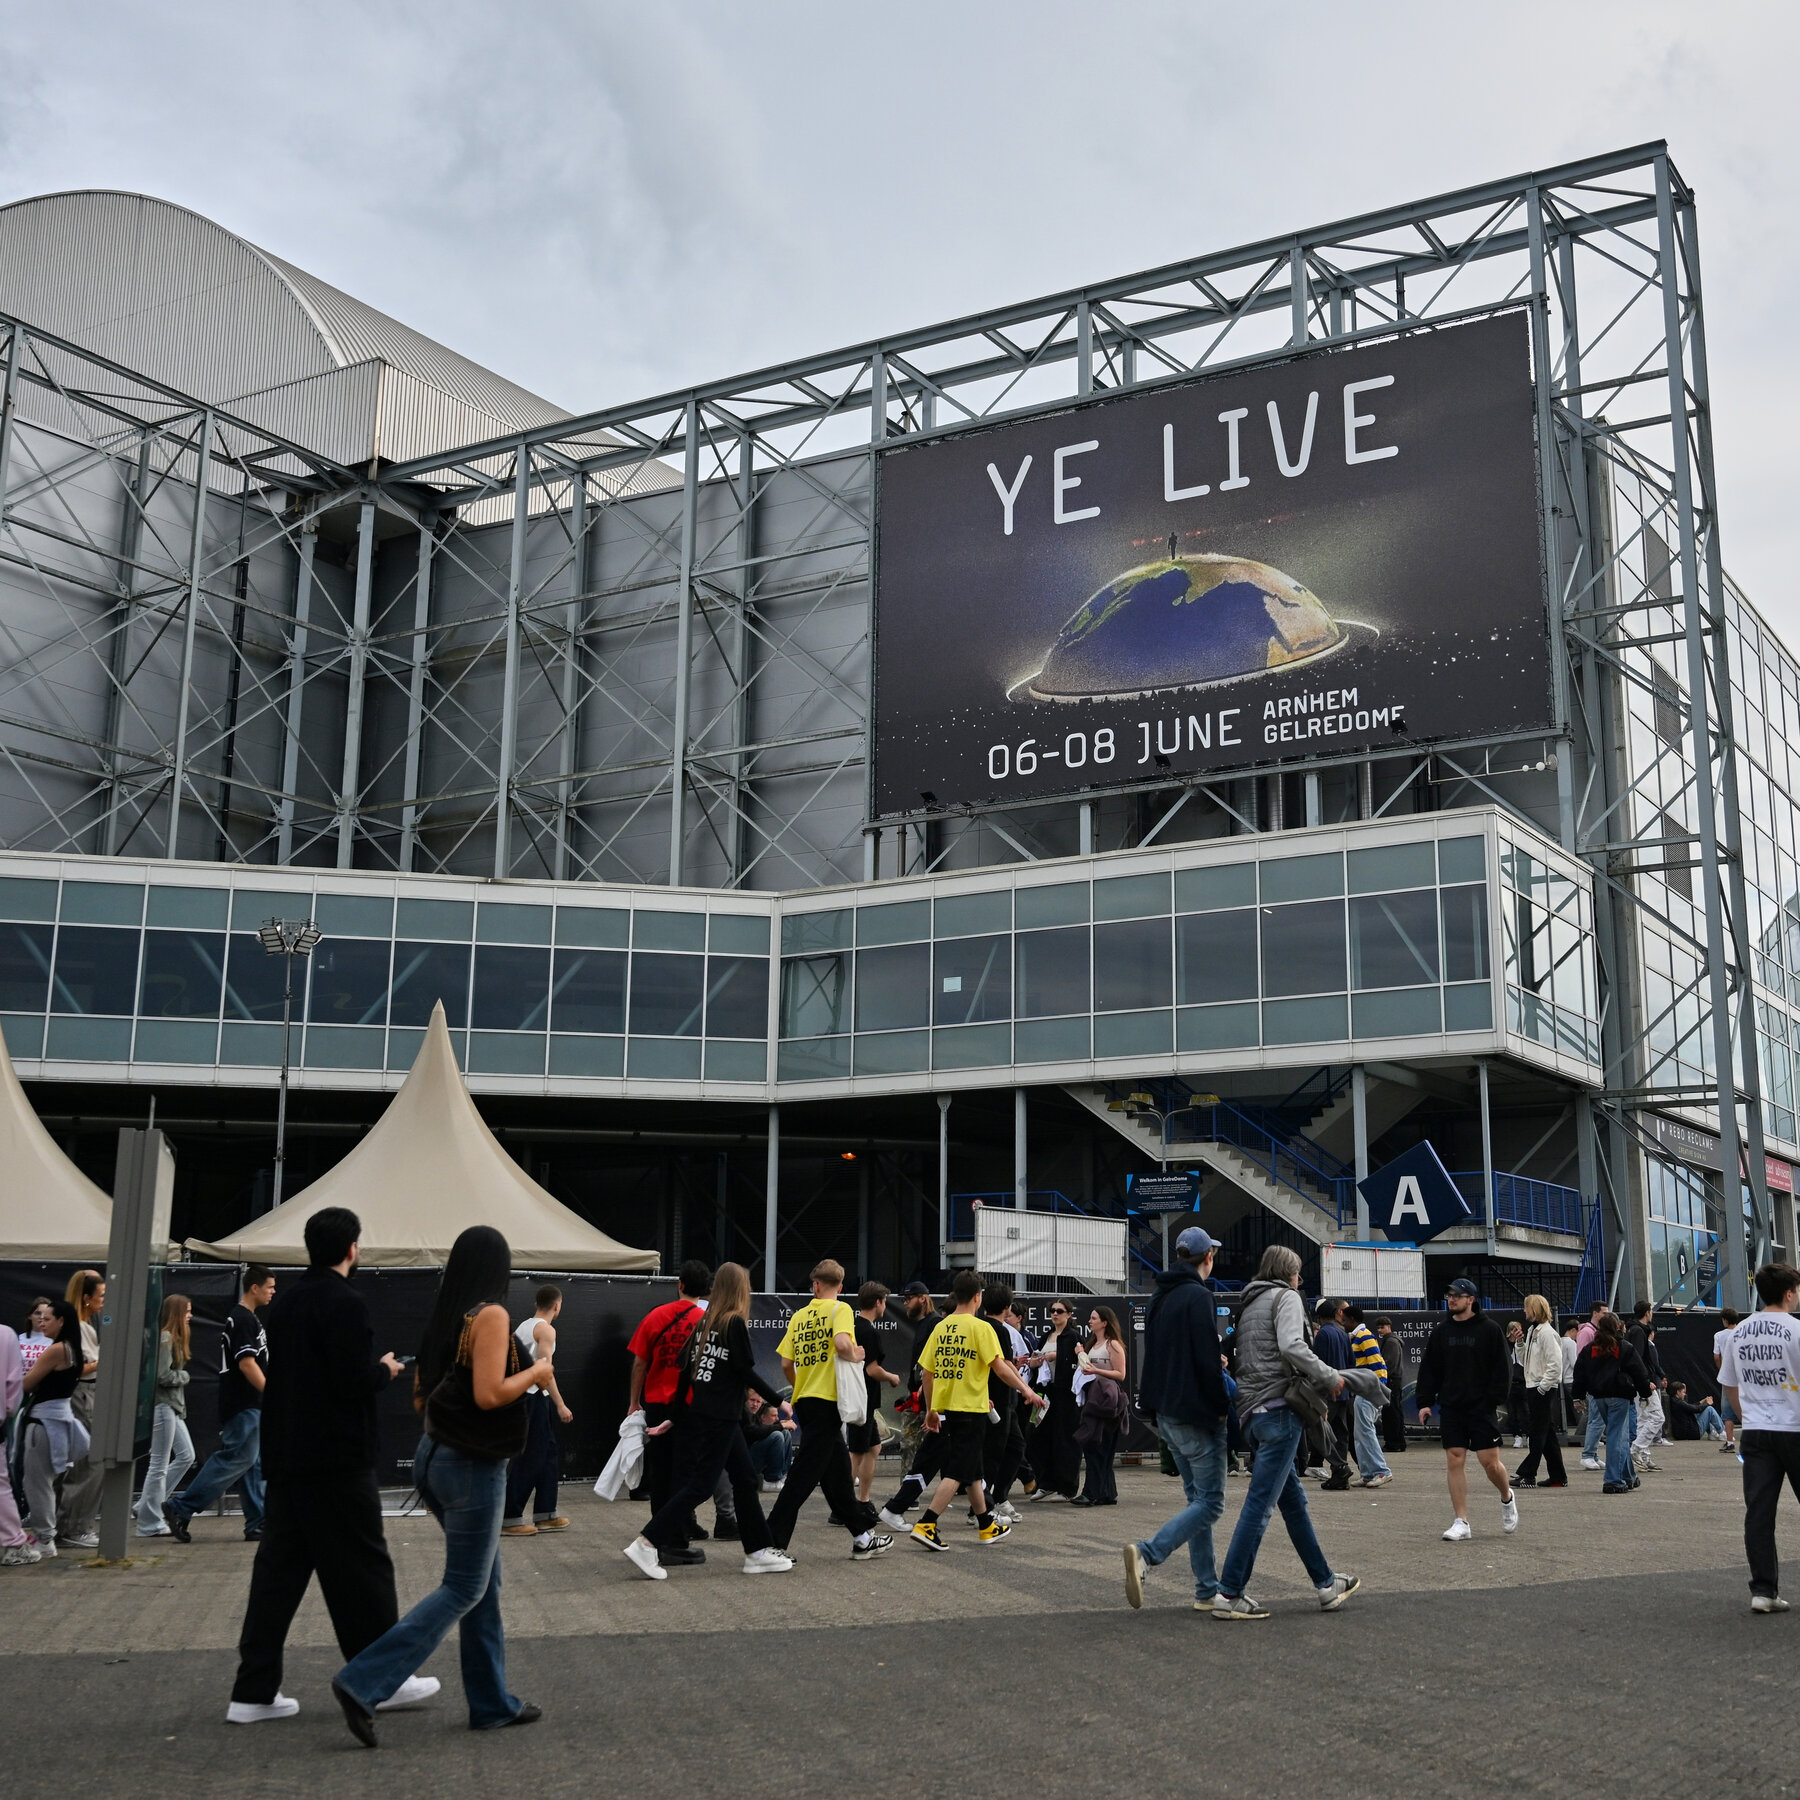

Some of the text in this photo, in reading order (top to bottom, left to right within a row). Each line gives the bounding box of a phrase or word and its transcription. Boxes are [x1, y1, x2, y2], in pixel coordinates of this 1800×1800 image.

[986, 374, 1400, 536] YE LIVE
[1263, 687, 1358, 720] ARNHEM
[1264, 705, 1405, 744] GELREDOME
[988, 708, 1242, 780] 06-08 JUNE
[1669, 1124, 1713, 1151] REBO RECLAME
[1388, 1174, 1431, 1226] A
[1680, 1254, 1686, 1275] B
[748, 1319, 790, 1329] GELREDO
[815, 1316, 828, 1328] AT
[871, 1321, 898, 1330] NHEM
[946, 1324, 958, 1333] YE
[1402, 1321, 1434, 1330] YE LIVE
[20, 1343, 47, 1351] KANY
[953, 1334, 967, 1345] AT
[1410, 1347, 1421, 1355] 06
[1738, 1343, 1783, 1362] STARRY
[1742, 1367, 1787, 1387] NIGHTS
